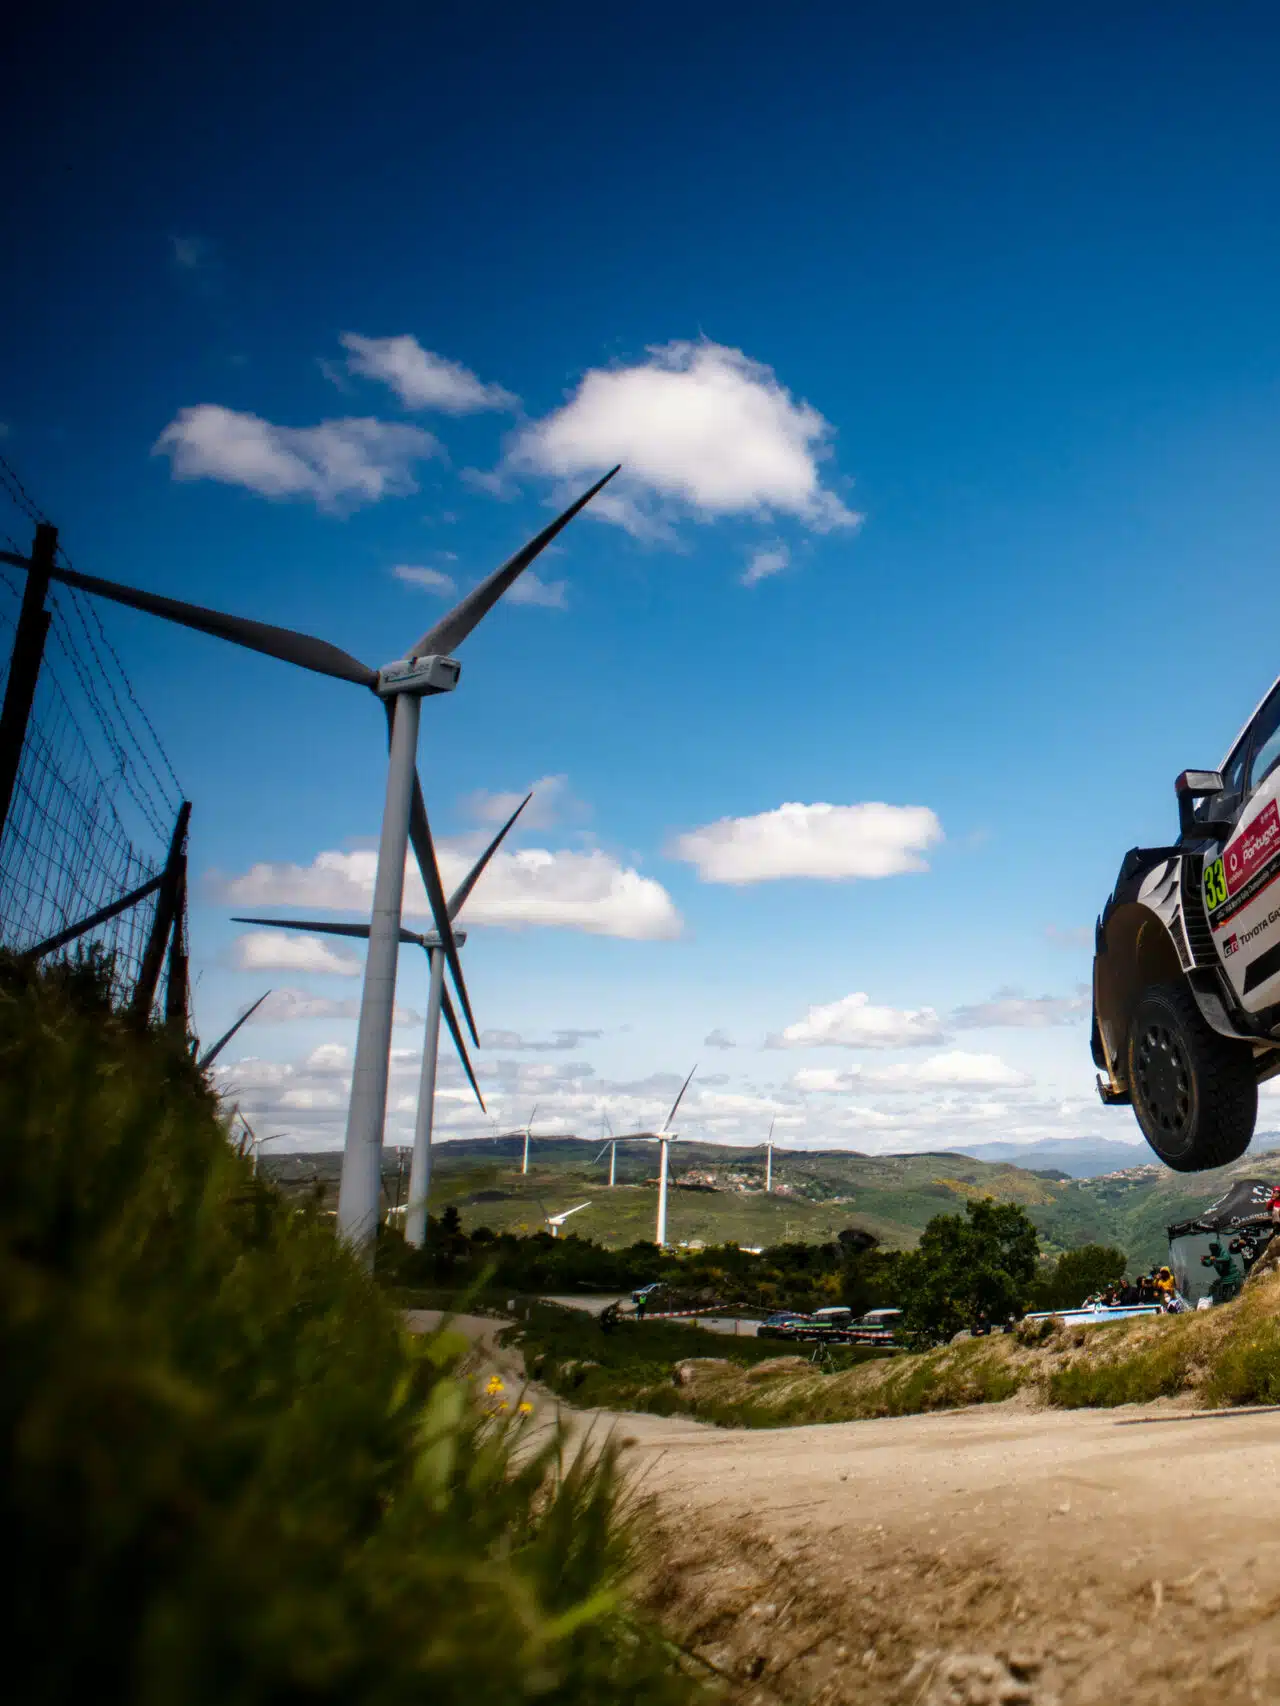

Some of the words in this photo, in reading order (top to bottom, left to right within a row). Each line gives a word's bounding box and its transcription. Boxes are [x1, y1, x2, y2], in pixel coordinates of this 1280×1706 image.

[1204, 858, 1227, 911] 33
[1224, 941, 1239, 958] GR
[1240, 919, 1270, 944] TOYOTA
